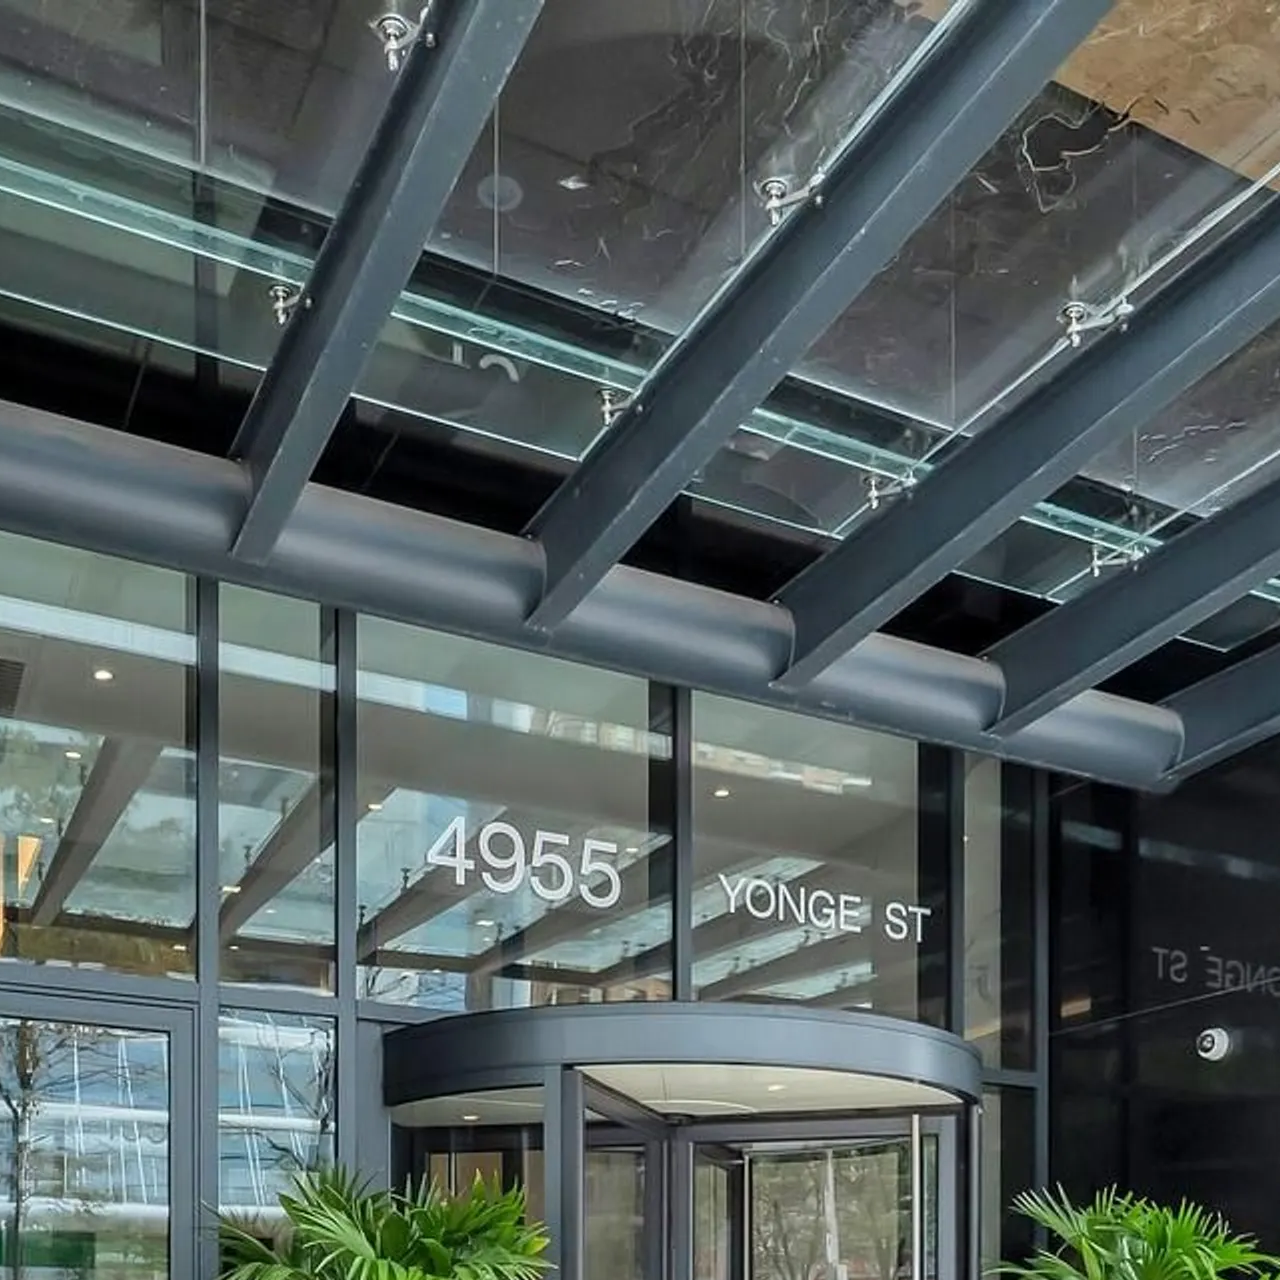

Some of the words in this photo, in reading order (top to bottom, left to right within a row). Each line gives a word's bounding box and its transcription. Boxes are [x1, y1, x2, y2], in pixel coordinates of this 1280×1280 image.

[426, 816, 621, 908] 4955
[718, 873, 862, 933] YONGE
[884, 902, 931, 943] ST
